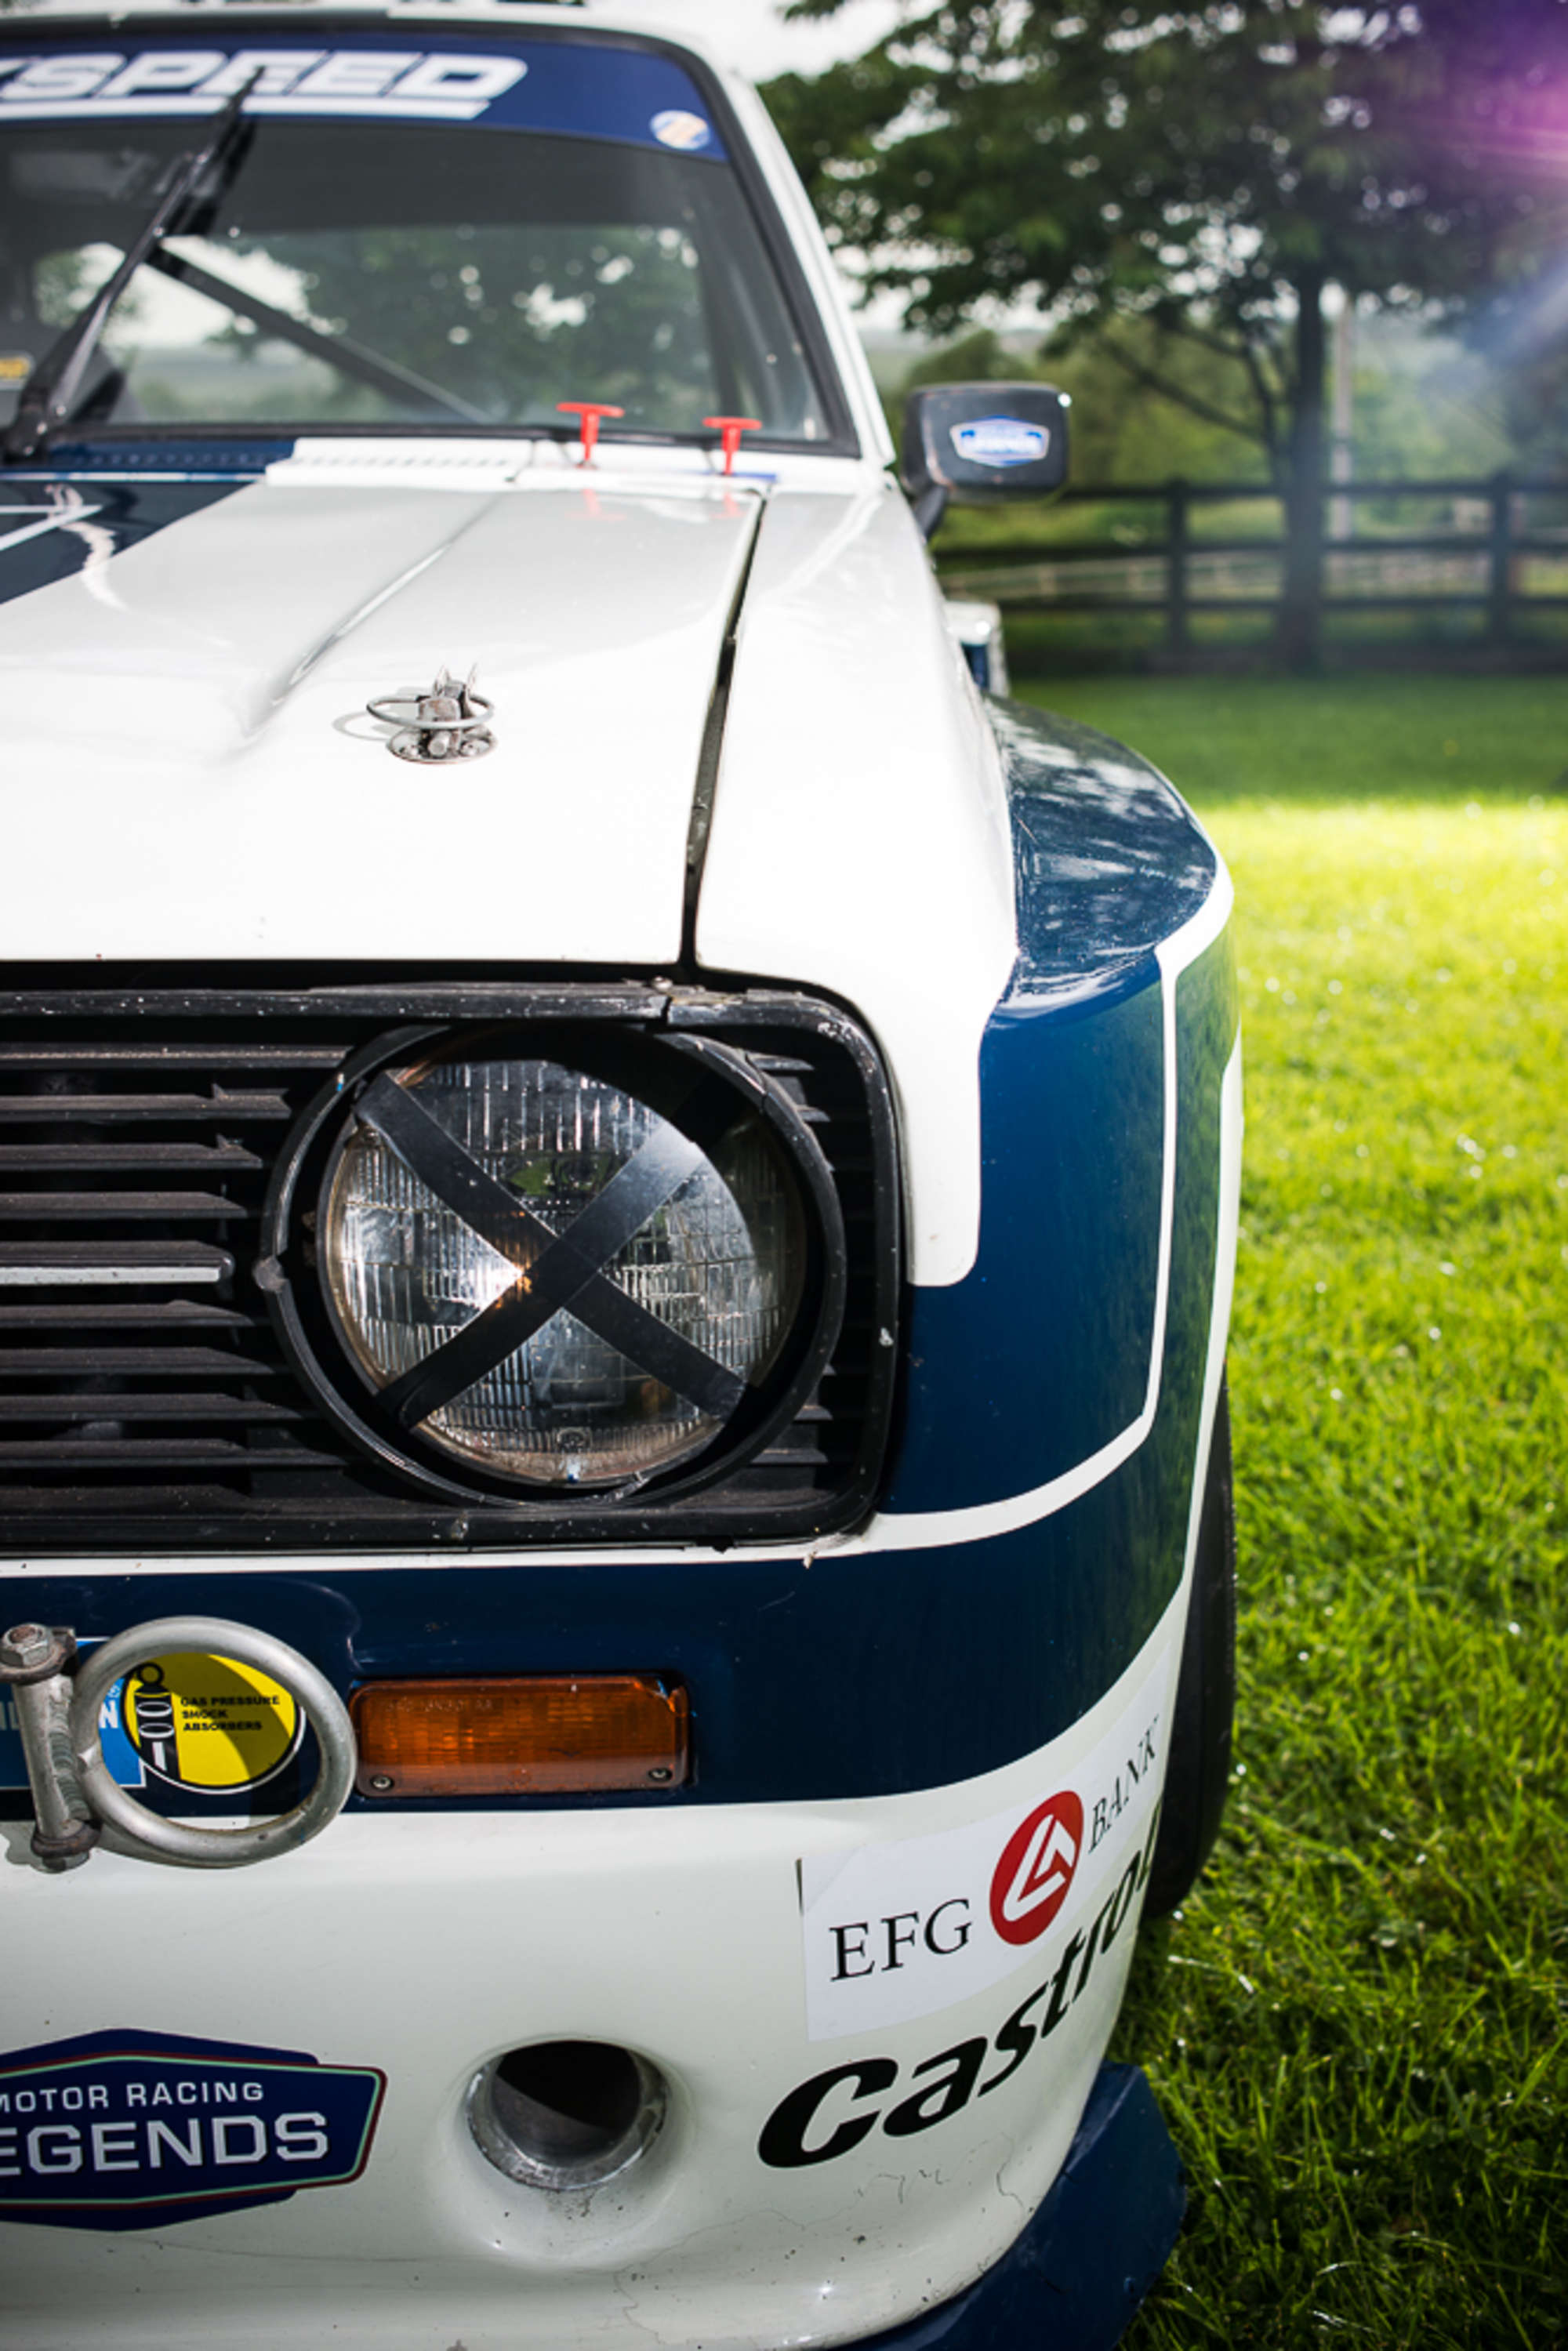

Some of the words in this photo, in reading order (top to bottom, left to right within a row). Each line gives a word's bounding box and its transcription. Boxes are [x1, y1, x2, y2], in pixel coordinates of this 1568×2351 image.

[180, 1696, 208, 1707] GAS
[211, 1695, 280, 1706] PRESSURE
[181, 1709, 228, 1720] SHOCK
[183, 1721, 263, 1732] ABSORBERS
[829, 1898, 974, 1983] EFG
[1087, 1714, 1160, 1855] BANK
[757, 1798, 1162, 2168] Castrol
[126, 2081, 264, 2107] RACING
